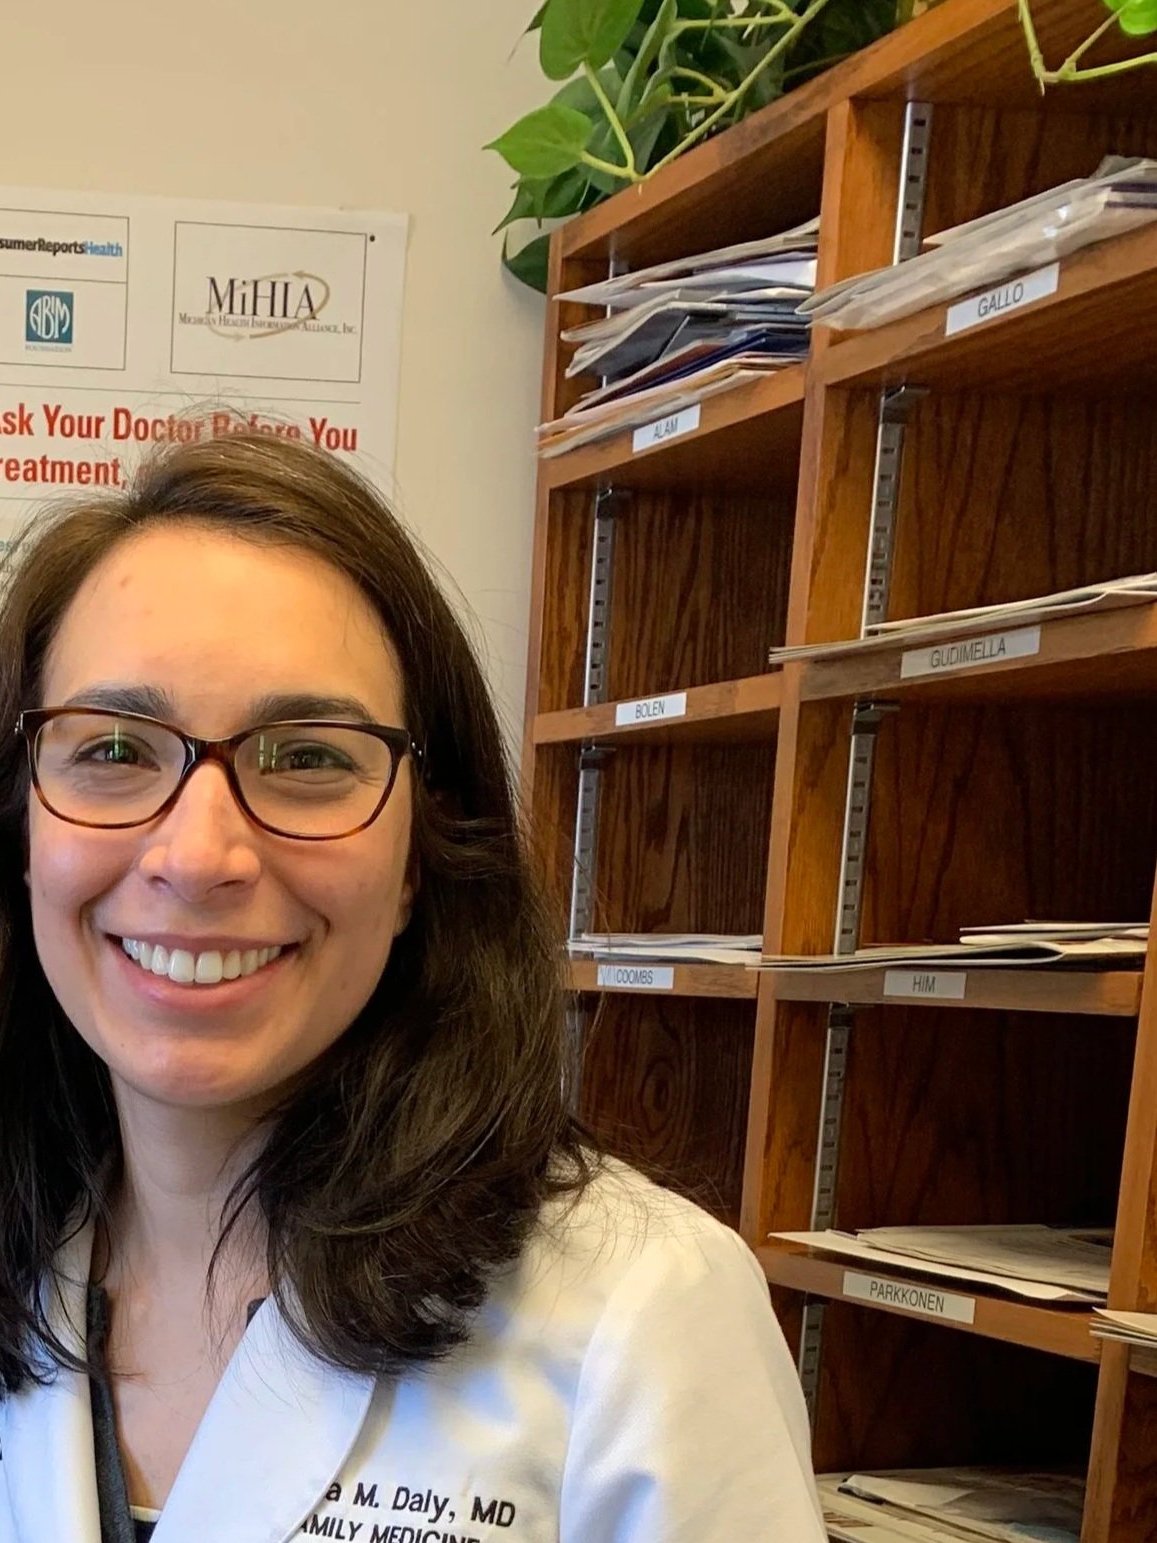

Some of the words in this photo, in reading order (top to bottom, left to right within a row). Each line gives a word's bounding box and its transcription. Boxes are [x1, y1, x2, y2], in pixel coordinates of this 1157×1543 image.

[977, 281, 1024, 317] GALLO
[43, 404, 106, 440] Your
[113, 407, 205, 444] Doctor
[309, 416, 358, 452] You
[653, 416, 679, 440] ALAM
[930, 637, 1006, 668] GUDIMELLA
[635, 700, 665, 719] BOLEN
[616, 967, 654, 985] COOMBS
[911, 974, 937, 993] HIM
[869, 1280, 945, 1312] PARKKONEN
[352, 1482, 381, 1509] M.
[391, 1485, 456, 1524] Daly,
[470, 1496, 517, 1529] MD
